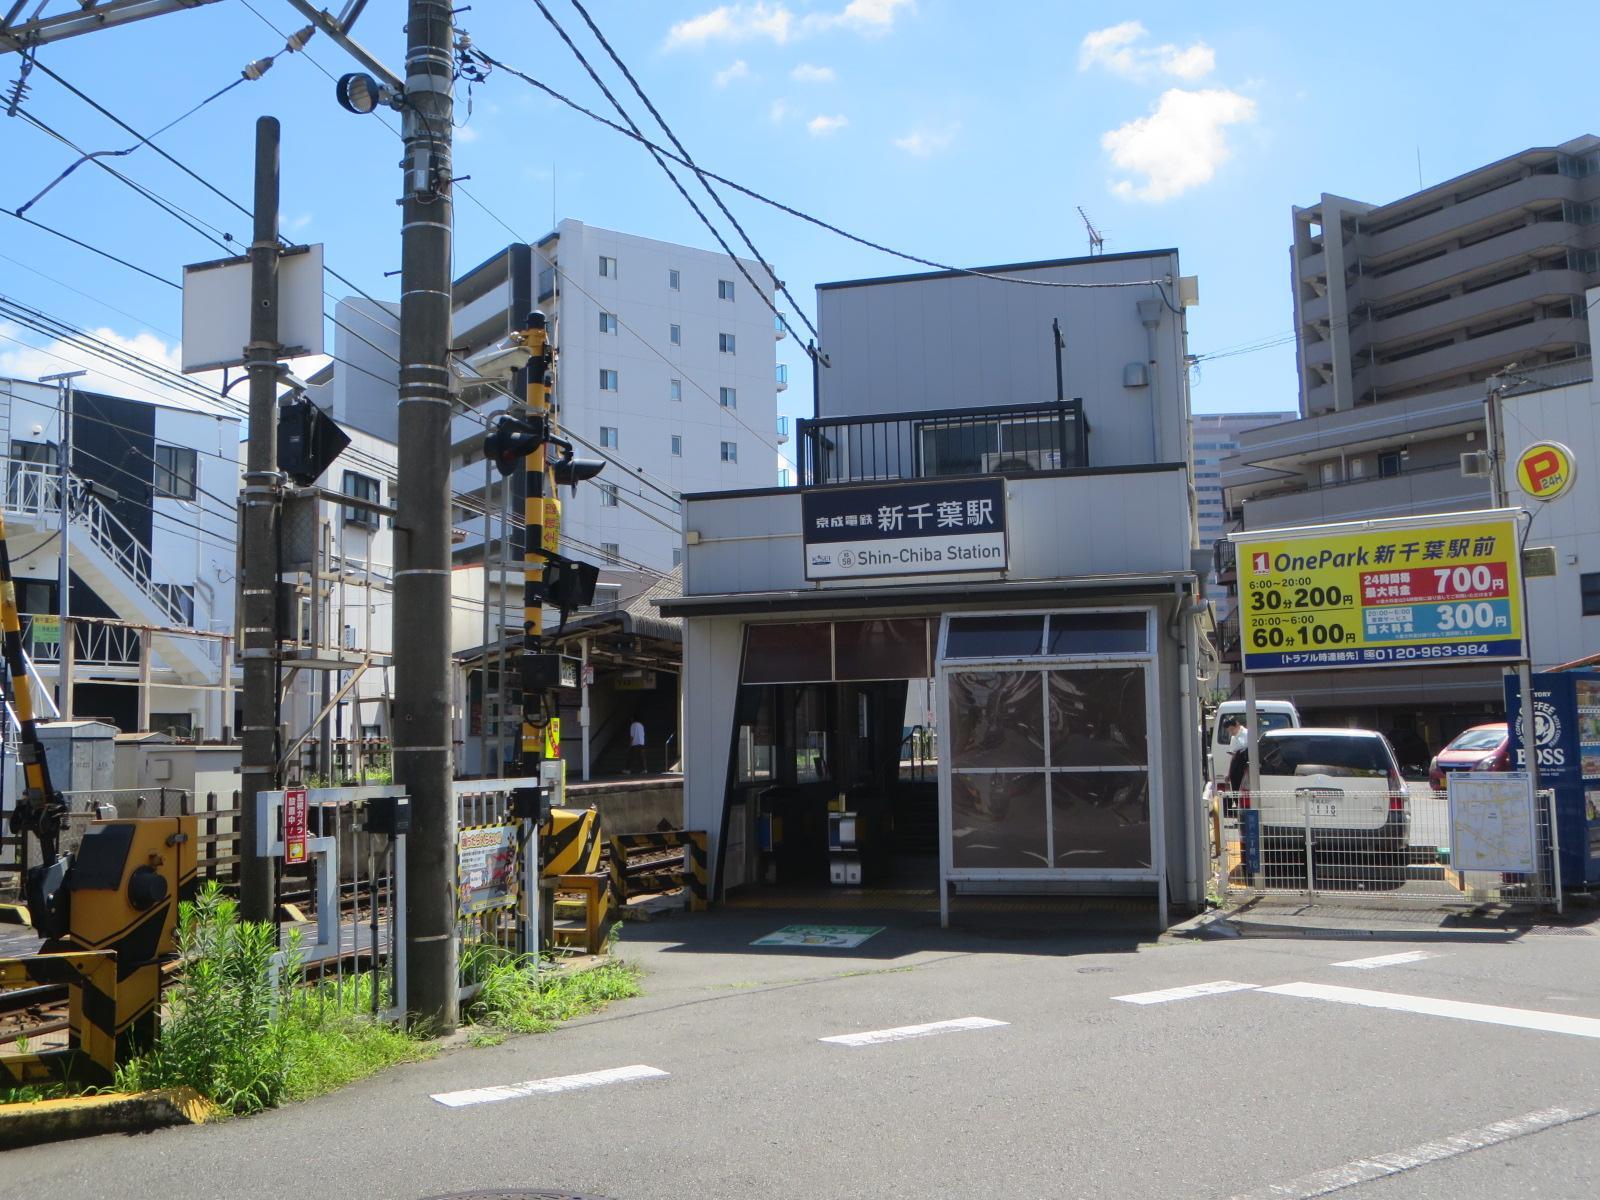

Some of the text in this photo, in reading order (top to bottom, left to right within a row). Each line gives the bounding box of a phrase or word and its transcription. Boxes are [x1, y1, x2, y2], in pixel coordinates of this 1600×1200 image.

[1524, 451, 1559, 493] P
[1541, 474, 1563, 489] 24H
[878, 499, 994, 531] 新千葉駅
[842, 558, 852, 566] 58
[858, 545, 1001, 566] Shin-Chiba Station
[1274, 546, 1369, 572] OnePark
[1374, 536, 1496, 564] 新千葉駅前
[1434, 565, 1504, 593] 700円
[1437, 603, 1507, 630] 300円
[1375, 644, 1489, 660] 0120-963-984
